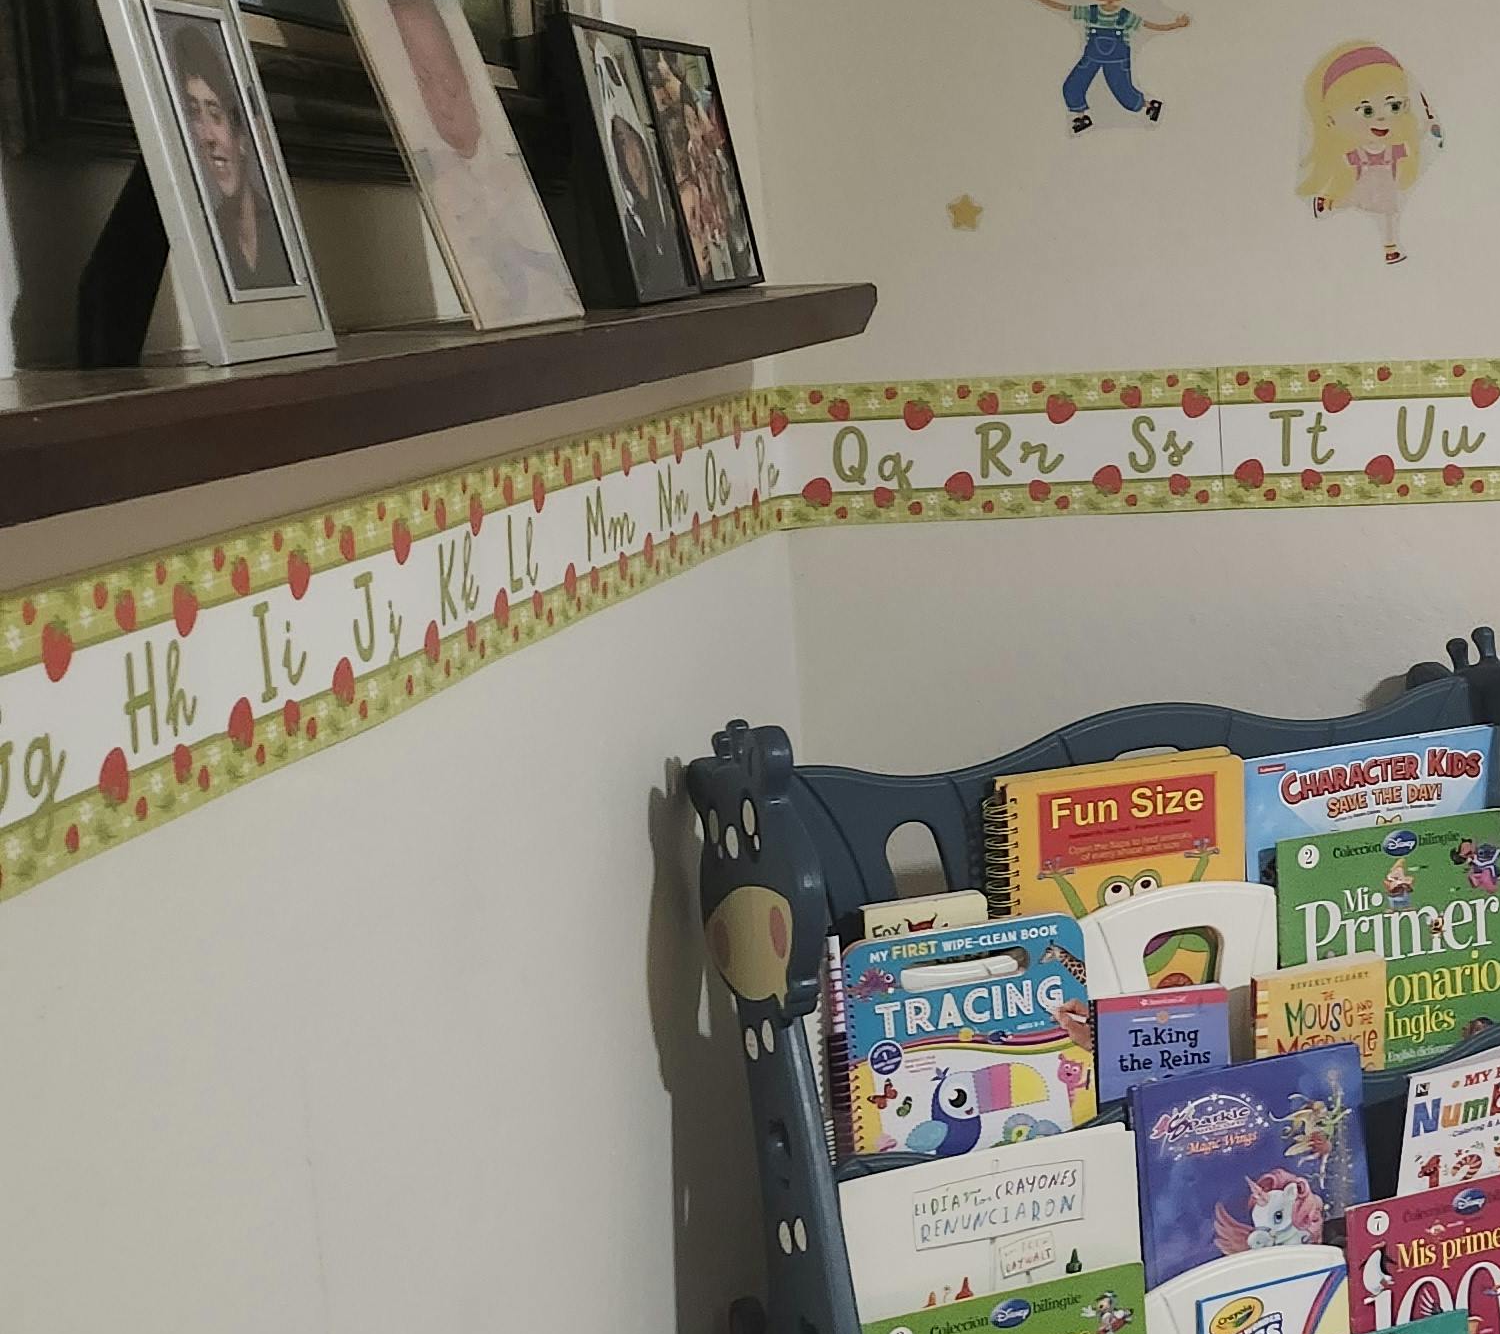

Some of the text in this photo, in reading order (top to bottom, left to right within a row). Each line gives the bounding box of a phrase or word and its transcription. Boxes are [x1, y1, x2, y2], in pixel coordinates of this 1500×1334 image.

[975, 421, 1064, 479] Rr
[1128, 416, 1194, 473] Ss
[1269, 410, 1335, 467] Tt
[1396, 405, 1485, 463] Uu
[124, 639, 197, 754] Hh
[252, 601, 307, 703] Ii
[352, 571, 402, 664] Jj
[438, 531, 479, 625] Kk
[586, 486, 635, 562] Mm
[658, 464, 688, 531] Nn
[1281, 749, 1484, 805] CHARACTER KIDS
[1050, 797, 1119, 829] Fun
[1131, 786, 1204, 818] Size
[1327, 791, 1368, 818] SAVE
[1372, 786, 1402, 804] THE
[1406, 783, 1442, 804] DAY!
[1303, 848, 1313, 865] 2
[1343, 886, 1371, 914] Mi
[869, 924, 1058, 964] MY FIRST WIPE-CLEAN BOOK
[1295, 891, 1499, 964] Primer
[875, 975, 1065, 1039] TRACING
[1128, 1027, 1199, 1048] Taking
[1119, 1050, 1212, 1072] the Reins
[1464, 1071, 1493, 1087] MY
[995, 1169, 1078, 1199] CRAYONES
[920, 1194, 1076, 1244] RENUNCIARON
[1396, 1238, 1437, 1272] Mis
